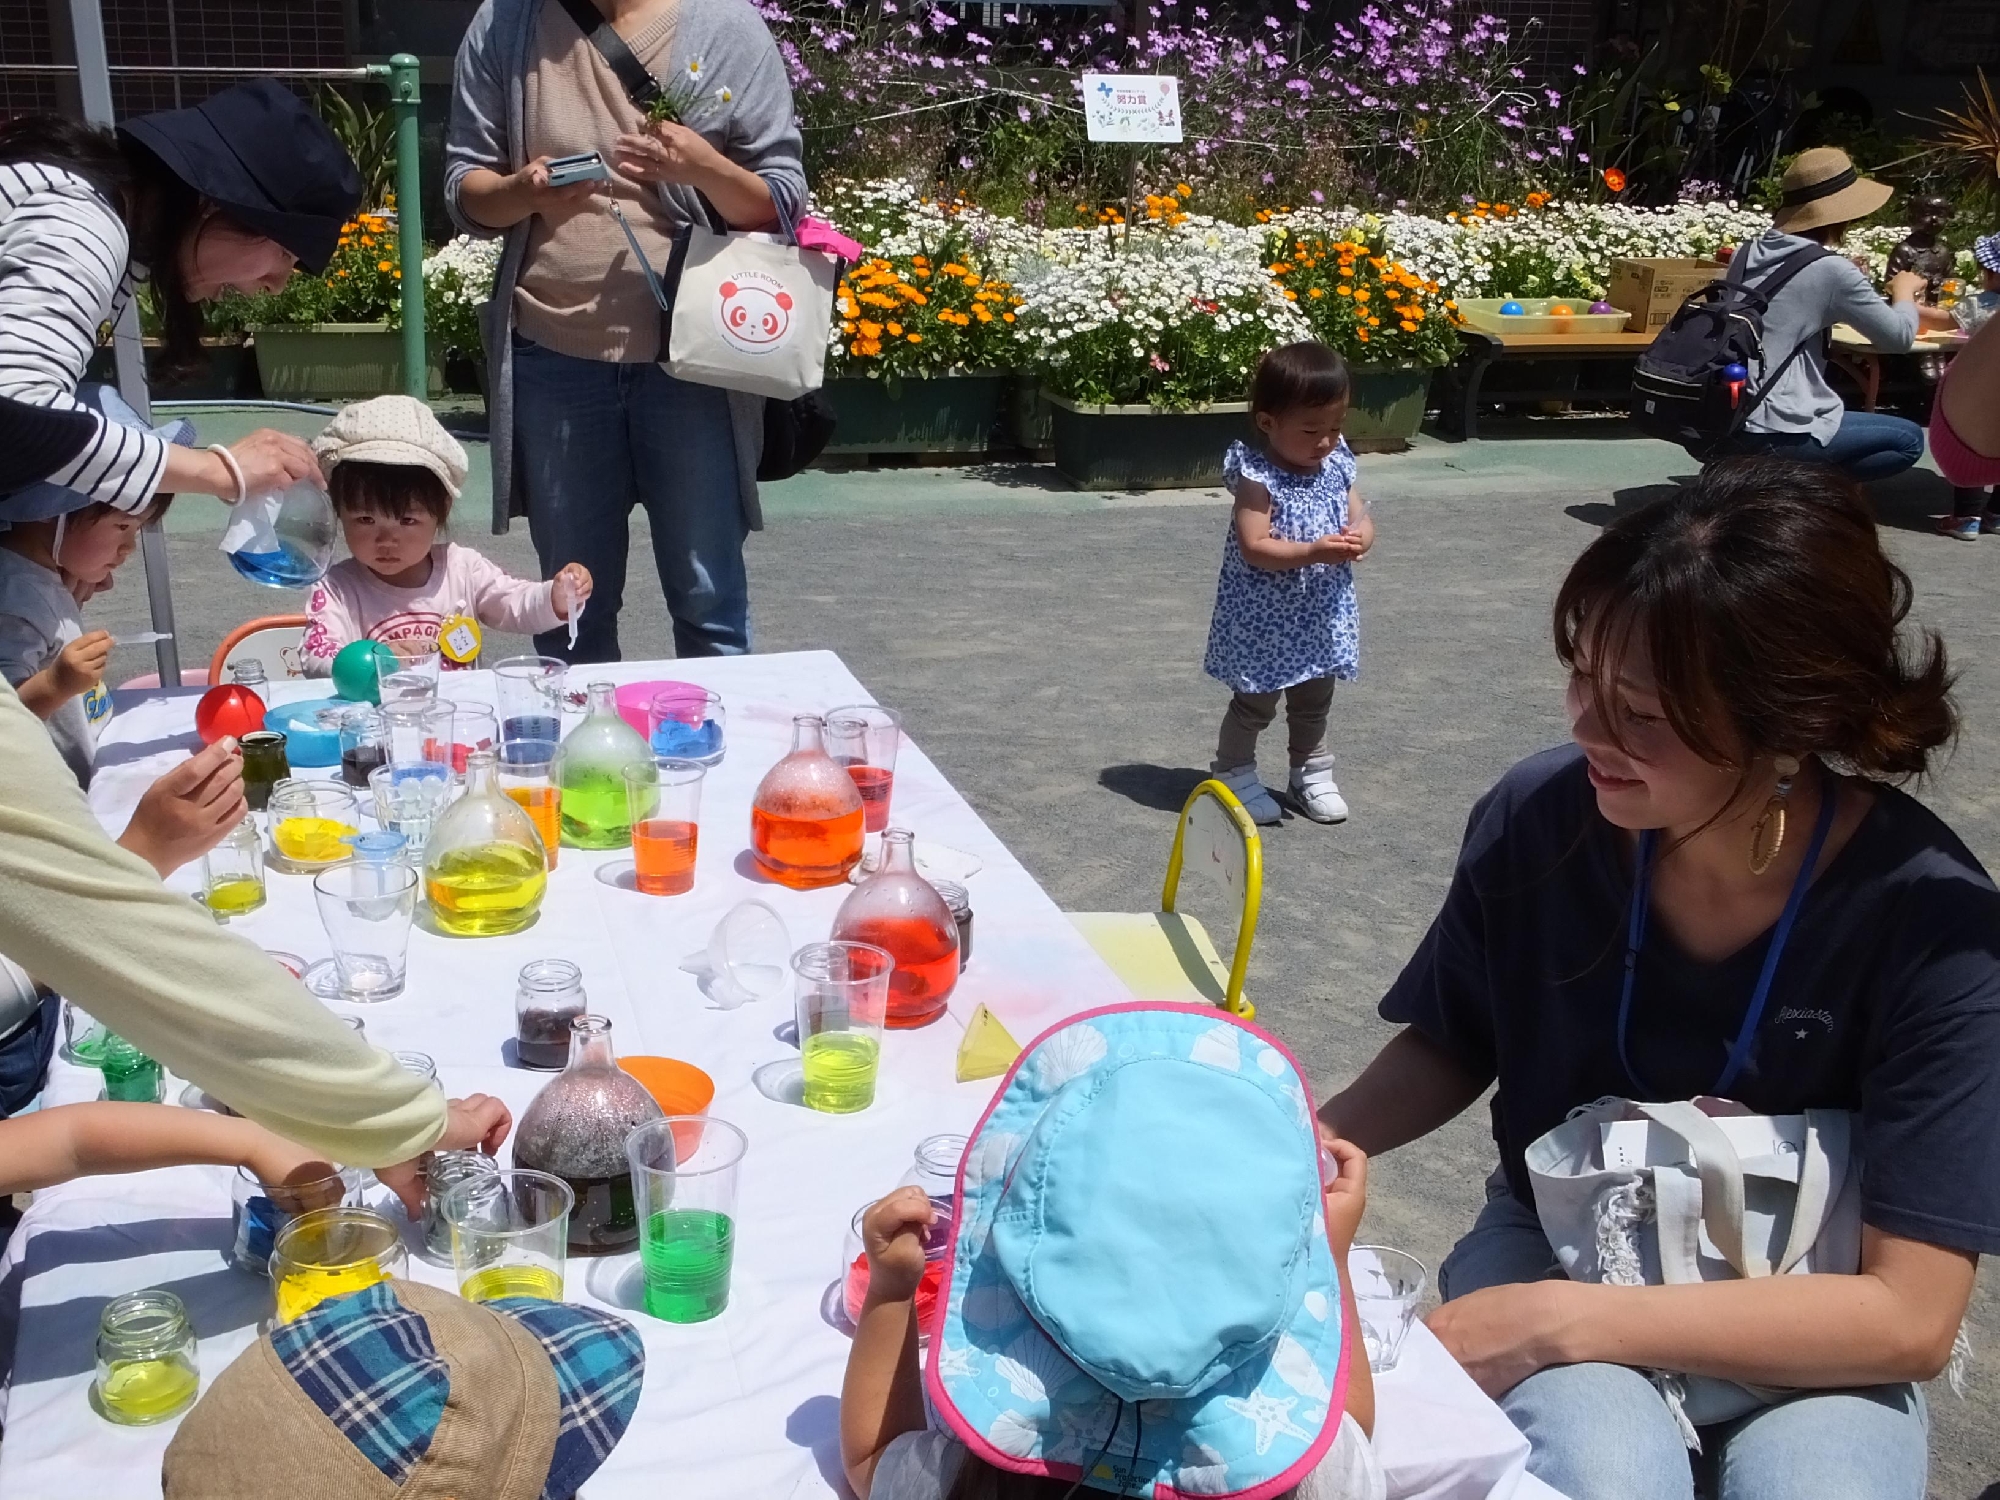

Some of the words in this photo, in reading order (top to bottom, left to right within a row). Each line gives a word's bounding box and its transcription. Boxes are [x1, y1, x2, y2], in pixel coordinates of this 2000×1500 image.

[1117, 94, 1147, 105] 努力賞
[731, 271, 759, 281] LITTLE
[761, 273, 784, 289] ROOM
[1113, 1465, 1127, 1474] Sun
